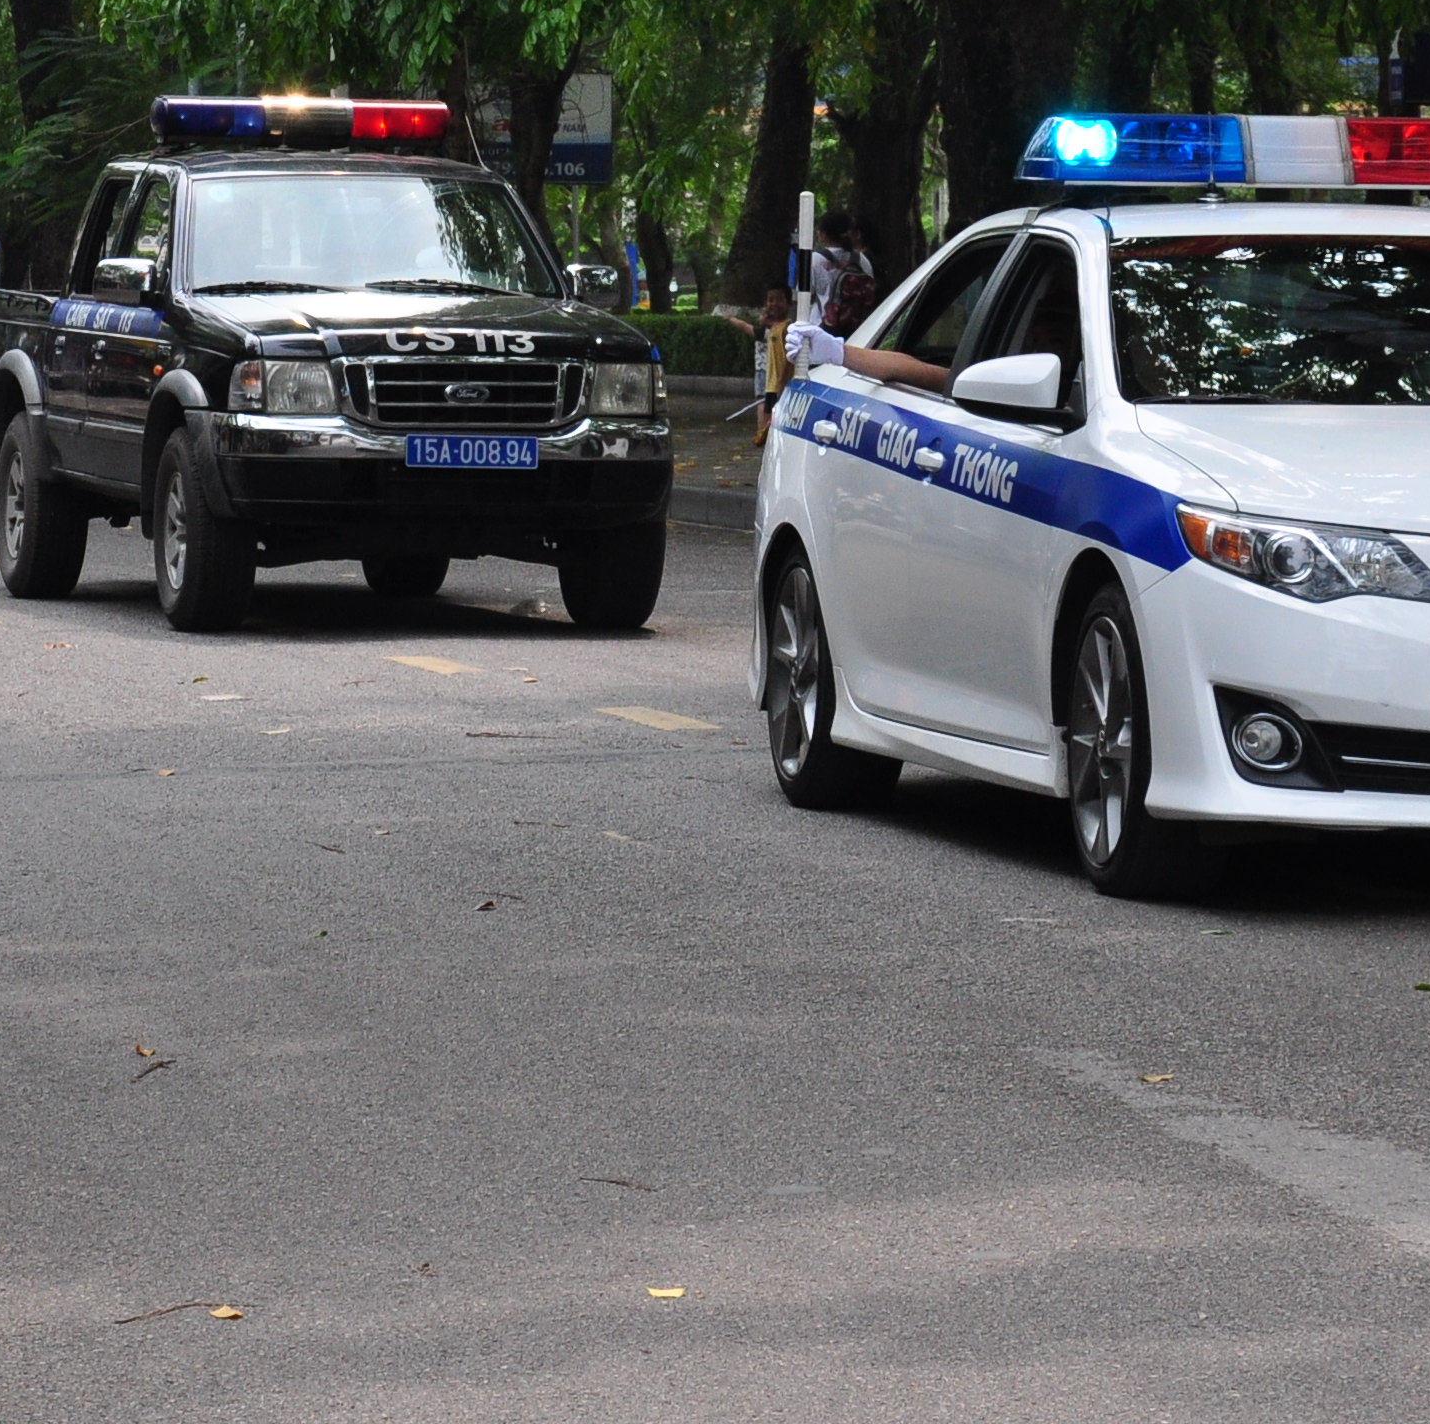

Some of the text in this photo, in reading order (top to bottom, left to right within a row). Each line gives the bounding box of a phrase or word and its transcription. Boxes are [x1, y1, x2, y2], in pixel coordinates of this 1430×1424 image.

[386, 328, 535, 354] CS 113
[456, 388, 479, 399] Ford
[413, 438, 533, 465] 15A-008.94
[836, 402, 871, 450] SÁT
[876, 419, 919, 469] GIAO
[949, 442, 1019, 504] THÔNG
